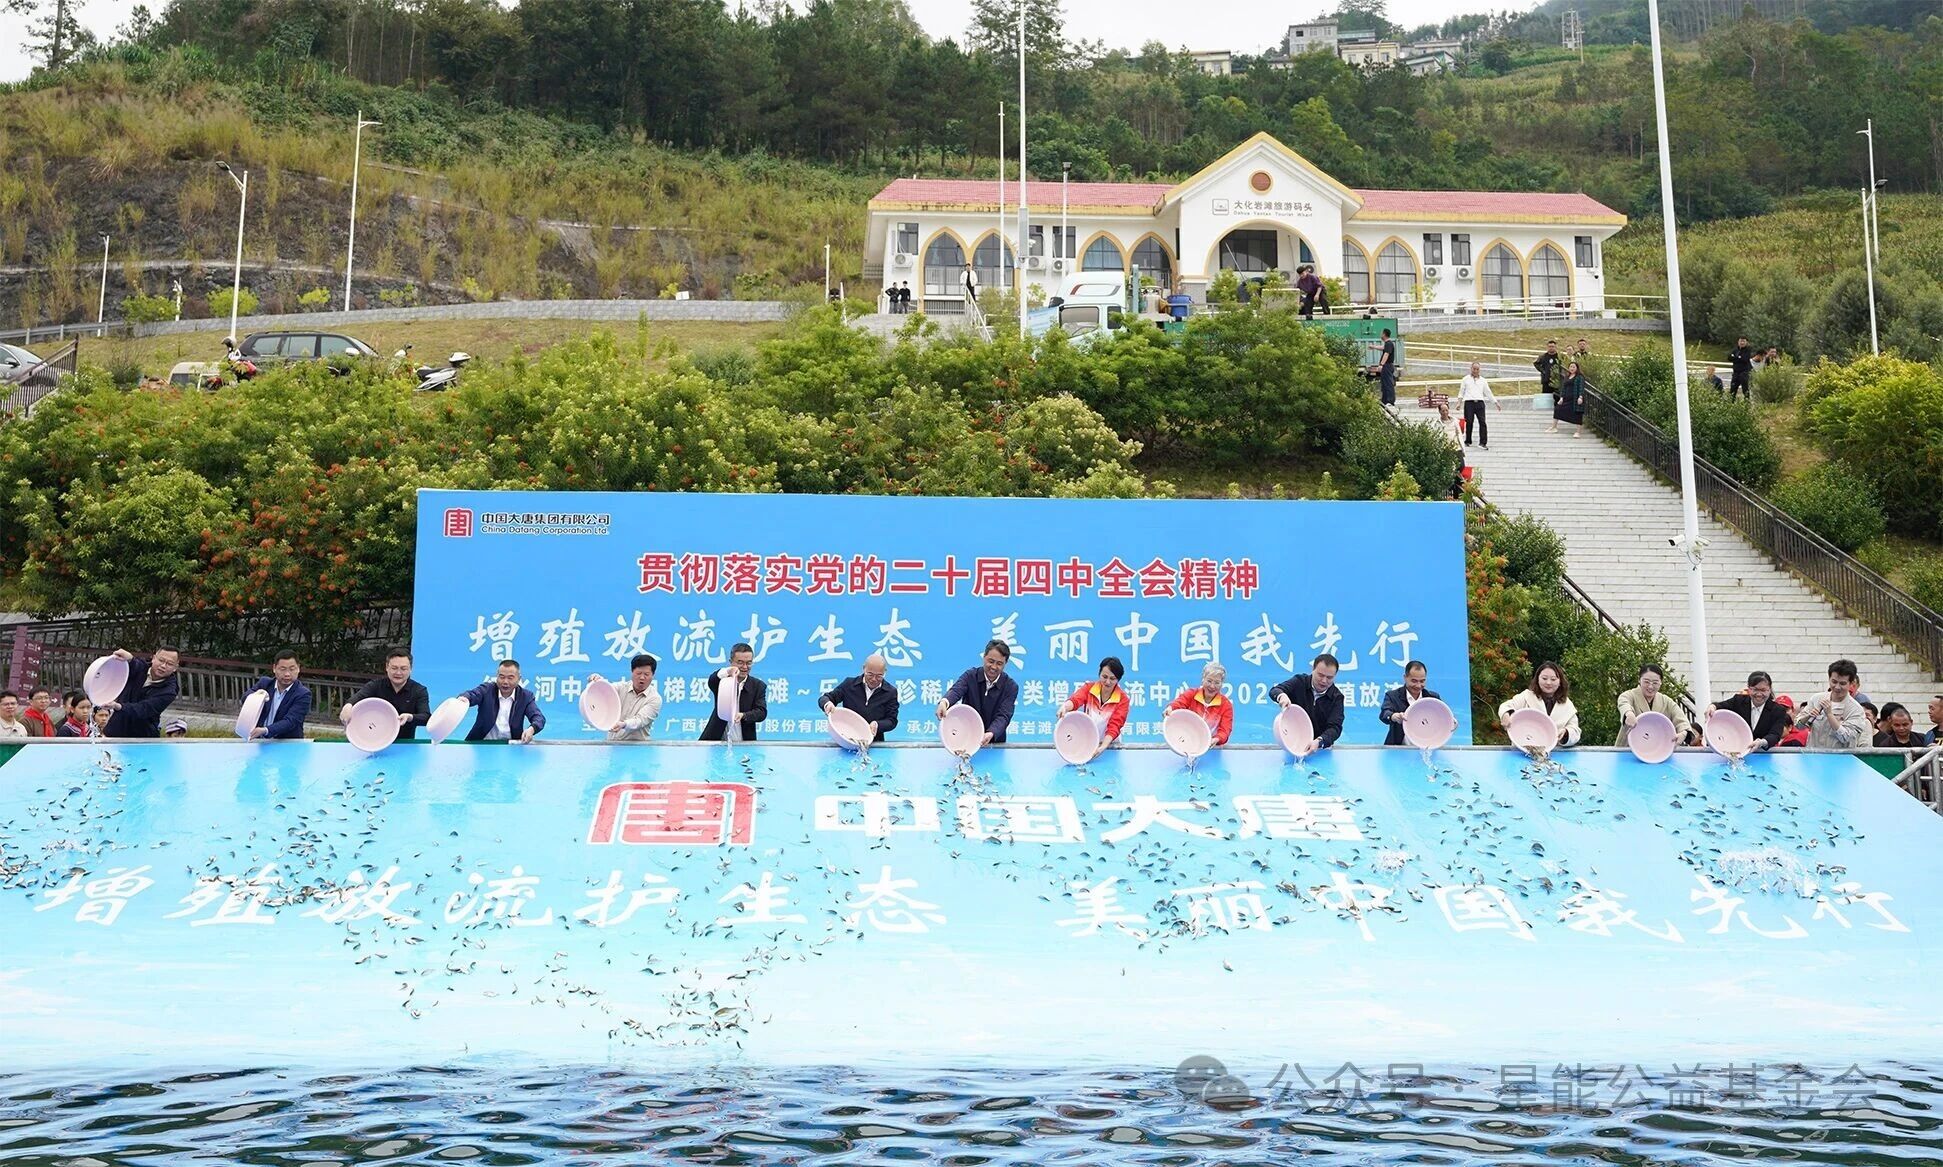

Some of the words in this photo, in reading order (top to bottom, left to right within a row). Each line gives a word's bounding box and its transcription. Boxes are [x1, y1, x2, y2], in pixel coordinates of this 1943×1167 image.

[1234, 201, 1313, 211] 大化岩滩旅游码头
[481, 513, 610, 525] 中国大唐集团有限公司
[481, 525, 506, 534] China
[509, 525, 540, 535] Datang
[543, 526, 592, 536] Corporation
[637, 552, 1259, 599] 贯彻落实党的二十届四中全会精神
[469, 607, 922, 667] 增殖放流护生态
[981, 611, 1419, 672] 美丽中国我先行
[814, 792, 1364, 843] 中国大唐
[34, 862, 946, 933] 增殖放流护生态
[1056, 871, 1911, 943] 美丽中国我先行
